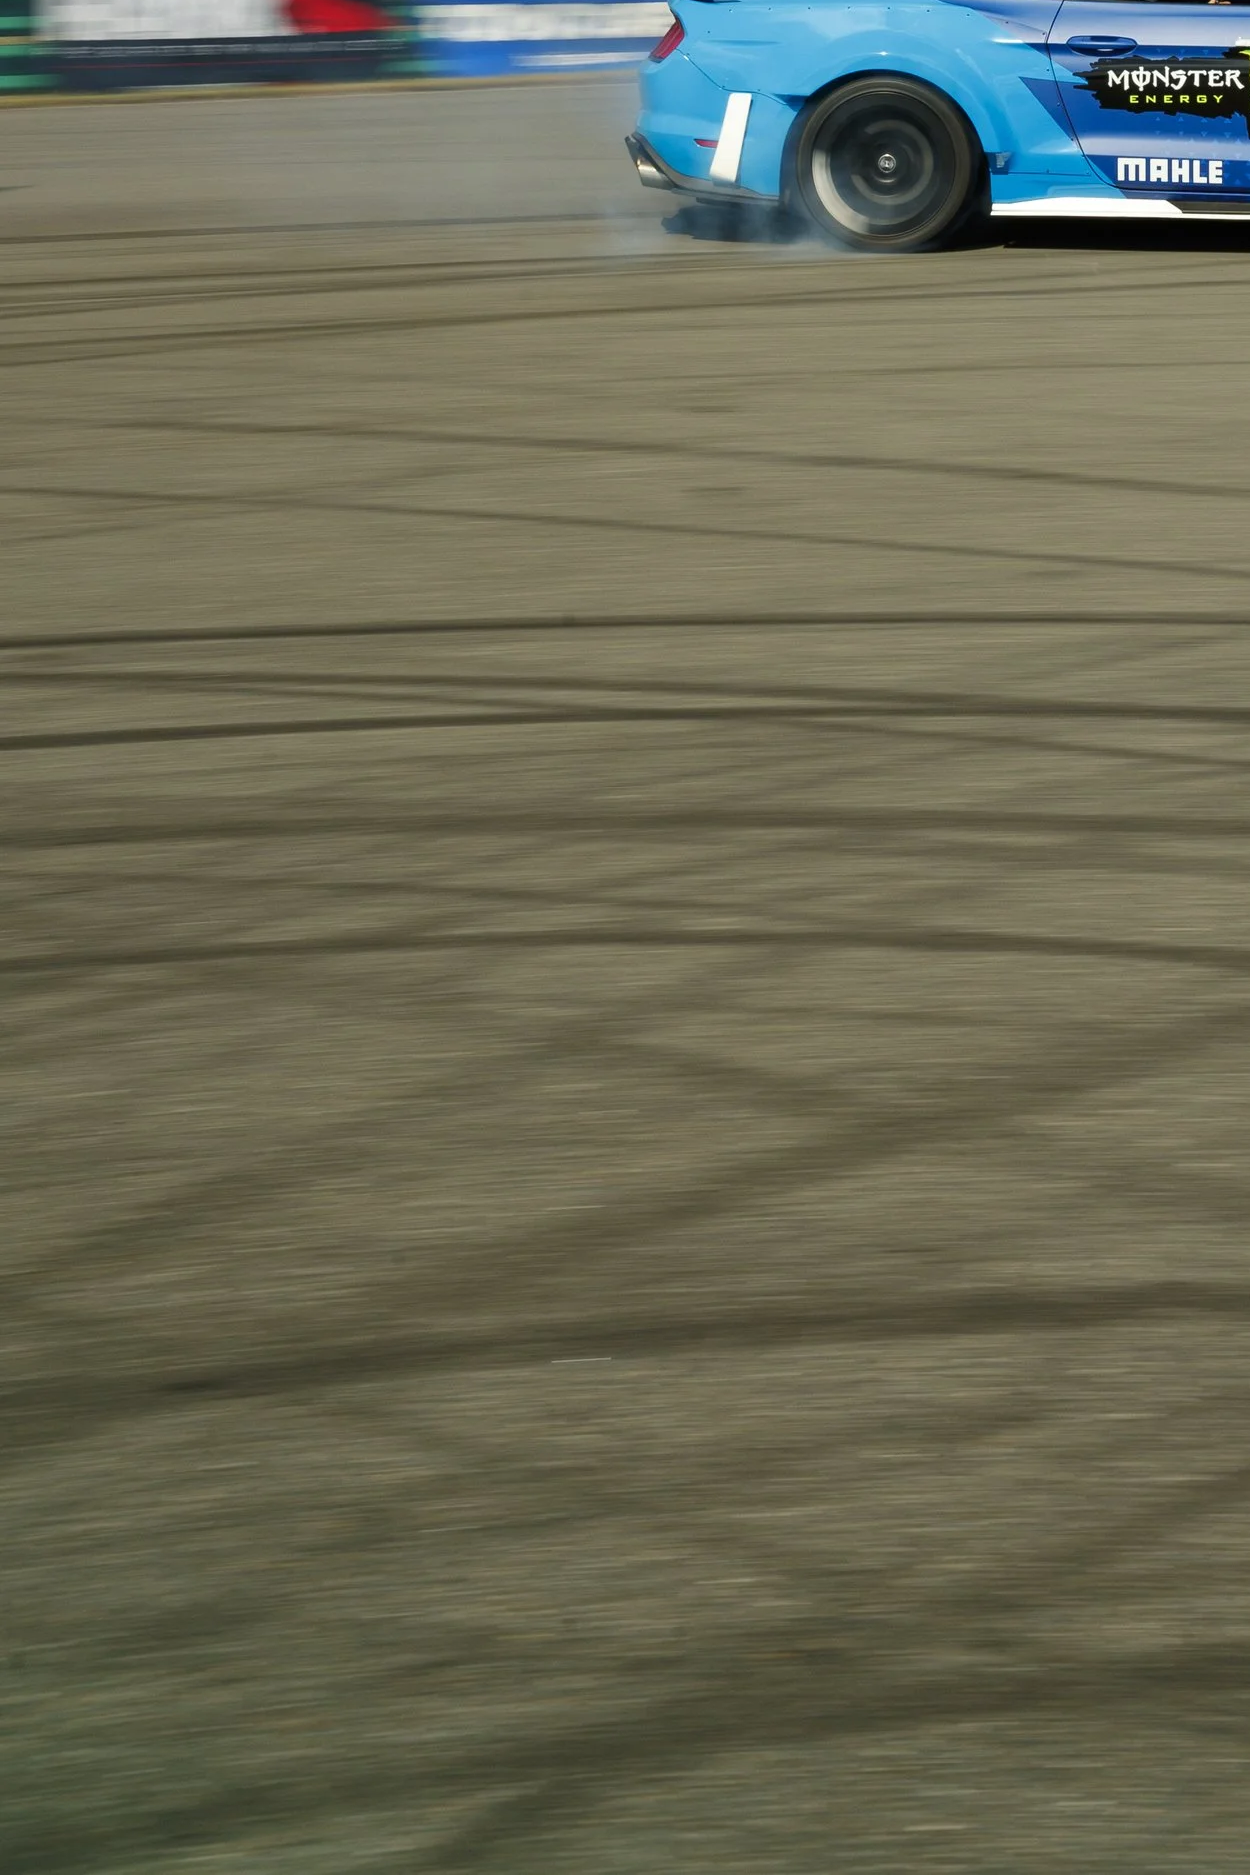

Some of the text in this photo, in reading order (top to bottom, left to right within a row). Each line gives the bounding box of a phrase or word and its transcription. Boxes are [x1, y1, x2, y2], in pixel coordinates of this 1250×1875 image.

[1107, 65, 1245, 92] MONSTER
[1129, 94, 1223, 104] ENERGY
[1117, 157, 1223, 184] MAHLE
